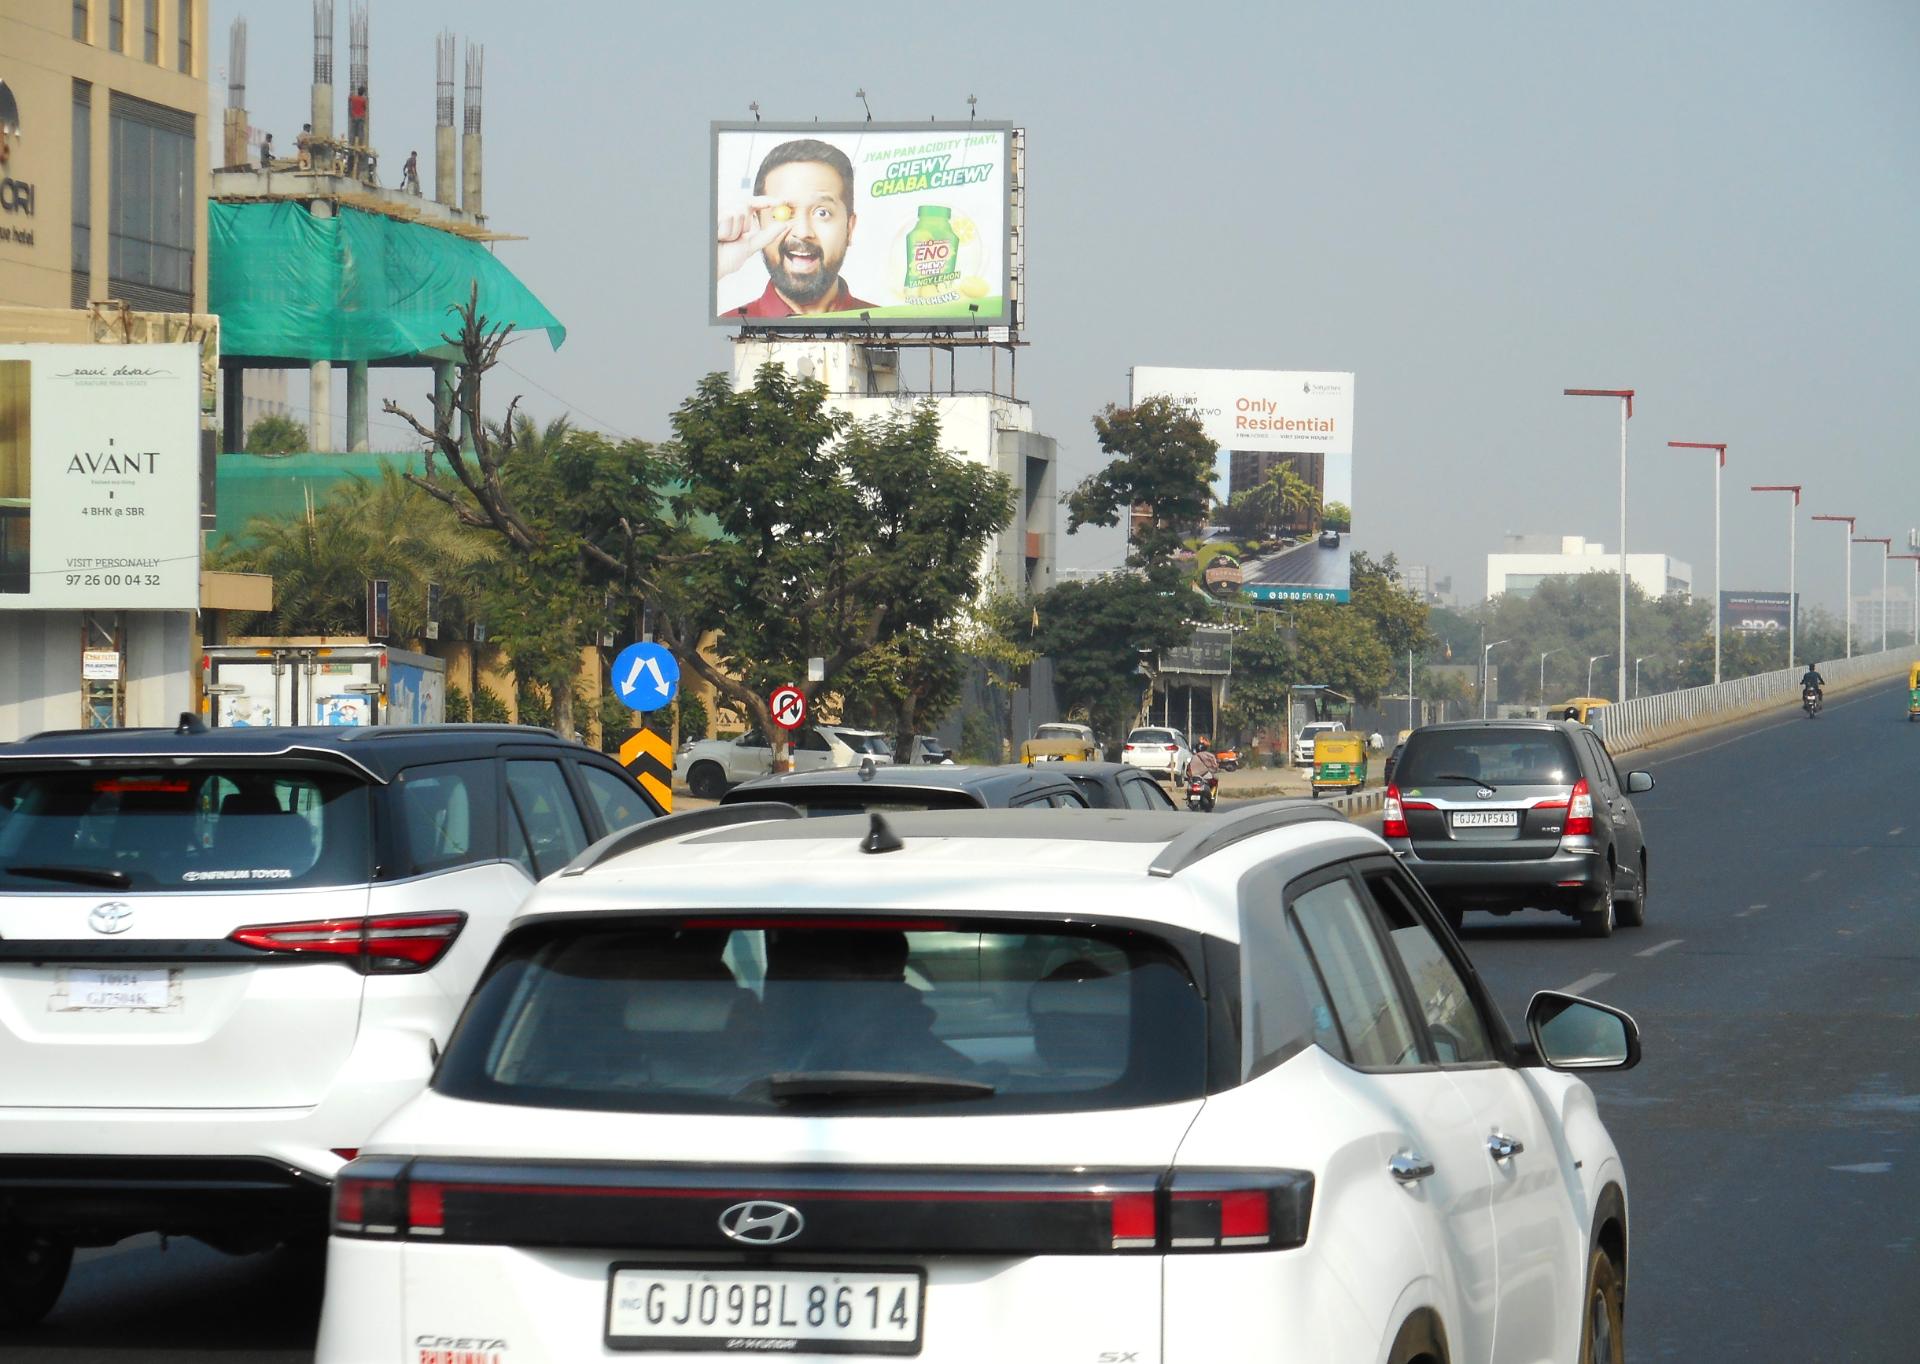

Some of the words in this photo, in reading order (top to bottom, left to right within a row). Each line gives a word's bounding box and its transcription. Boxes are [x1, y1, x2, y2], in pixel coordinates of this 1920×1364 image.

[864, 150, 891, 162] JYAN
[893, 147, 916, 158] PAN
[917, 139, 961, 155] ACIDITY
[888, 155, 950, 178] CHEWY
[872, 175, 928, 197] CHABA
[930, 164, 993, 188] CHEWY
[915, 245, 949, 261] ENO
[916, 260, 945, 270] CHEWY
[909, 277, 933, 288] TANGY
[933, 271, 961, 284] LEMON
[926, 291, 960, 305] CHEWS
[1236, 398, 1277, 415] Only
[1236, 416, 1334, 432] Residential
[66, 452, 160, 474] AVANT
[81, 507, 89, 516] 4
[90, 507, 113, 516] BHK
[114, 508, 123, 517] @
[125, 507, 145, 516] SBR
[66, 558, 93, 568] VISIT
[95, 558, 160, 568] PERSONALLY
[66, 574, 81, 586] 97
[84, 574, 101, 586] 26
[104, 574, 121, 586] 00
[124, 574, 141, 586] 04
[144, 574, 161, 586] 32
[1459, 811, 1516, 824] GJ27AP5431
[250, 869, 293, 879] TOYOTA
[645, 1282, 909, 1329] GJ09BL8614
[415, 1334, 507, 1350] CRETA
[1097, 1351, 1140, 1364] SX
